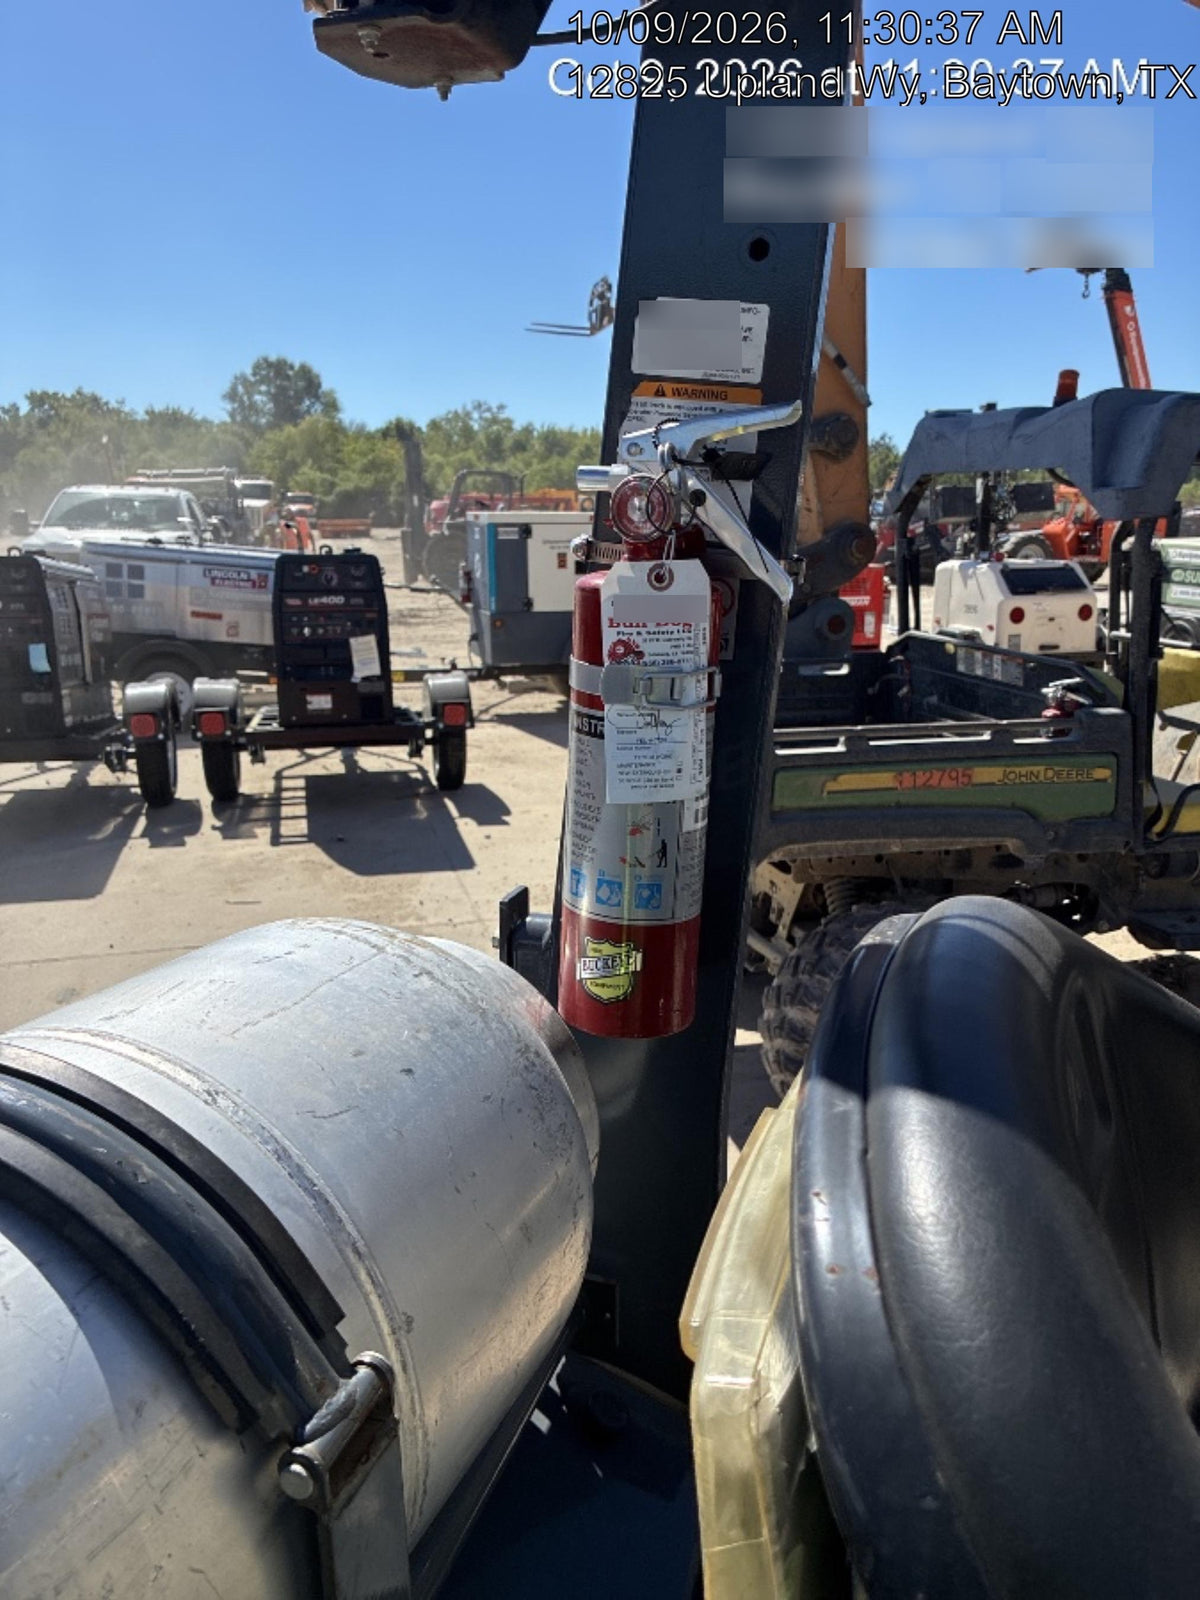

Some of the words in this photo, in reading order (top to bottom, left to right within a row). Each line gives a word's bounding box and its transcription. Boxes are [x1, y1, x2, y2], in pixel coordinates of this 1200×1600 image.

[671, 387, 729, 401] WARNING
[996, 769, 1041, 785] JOHN
[1043, 767, 1095, 781] DEERE
